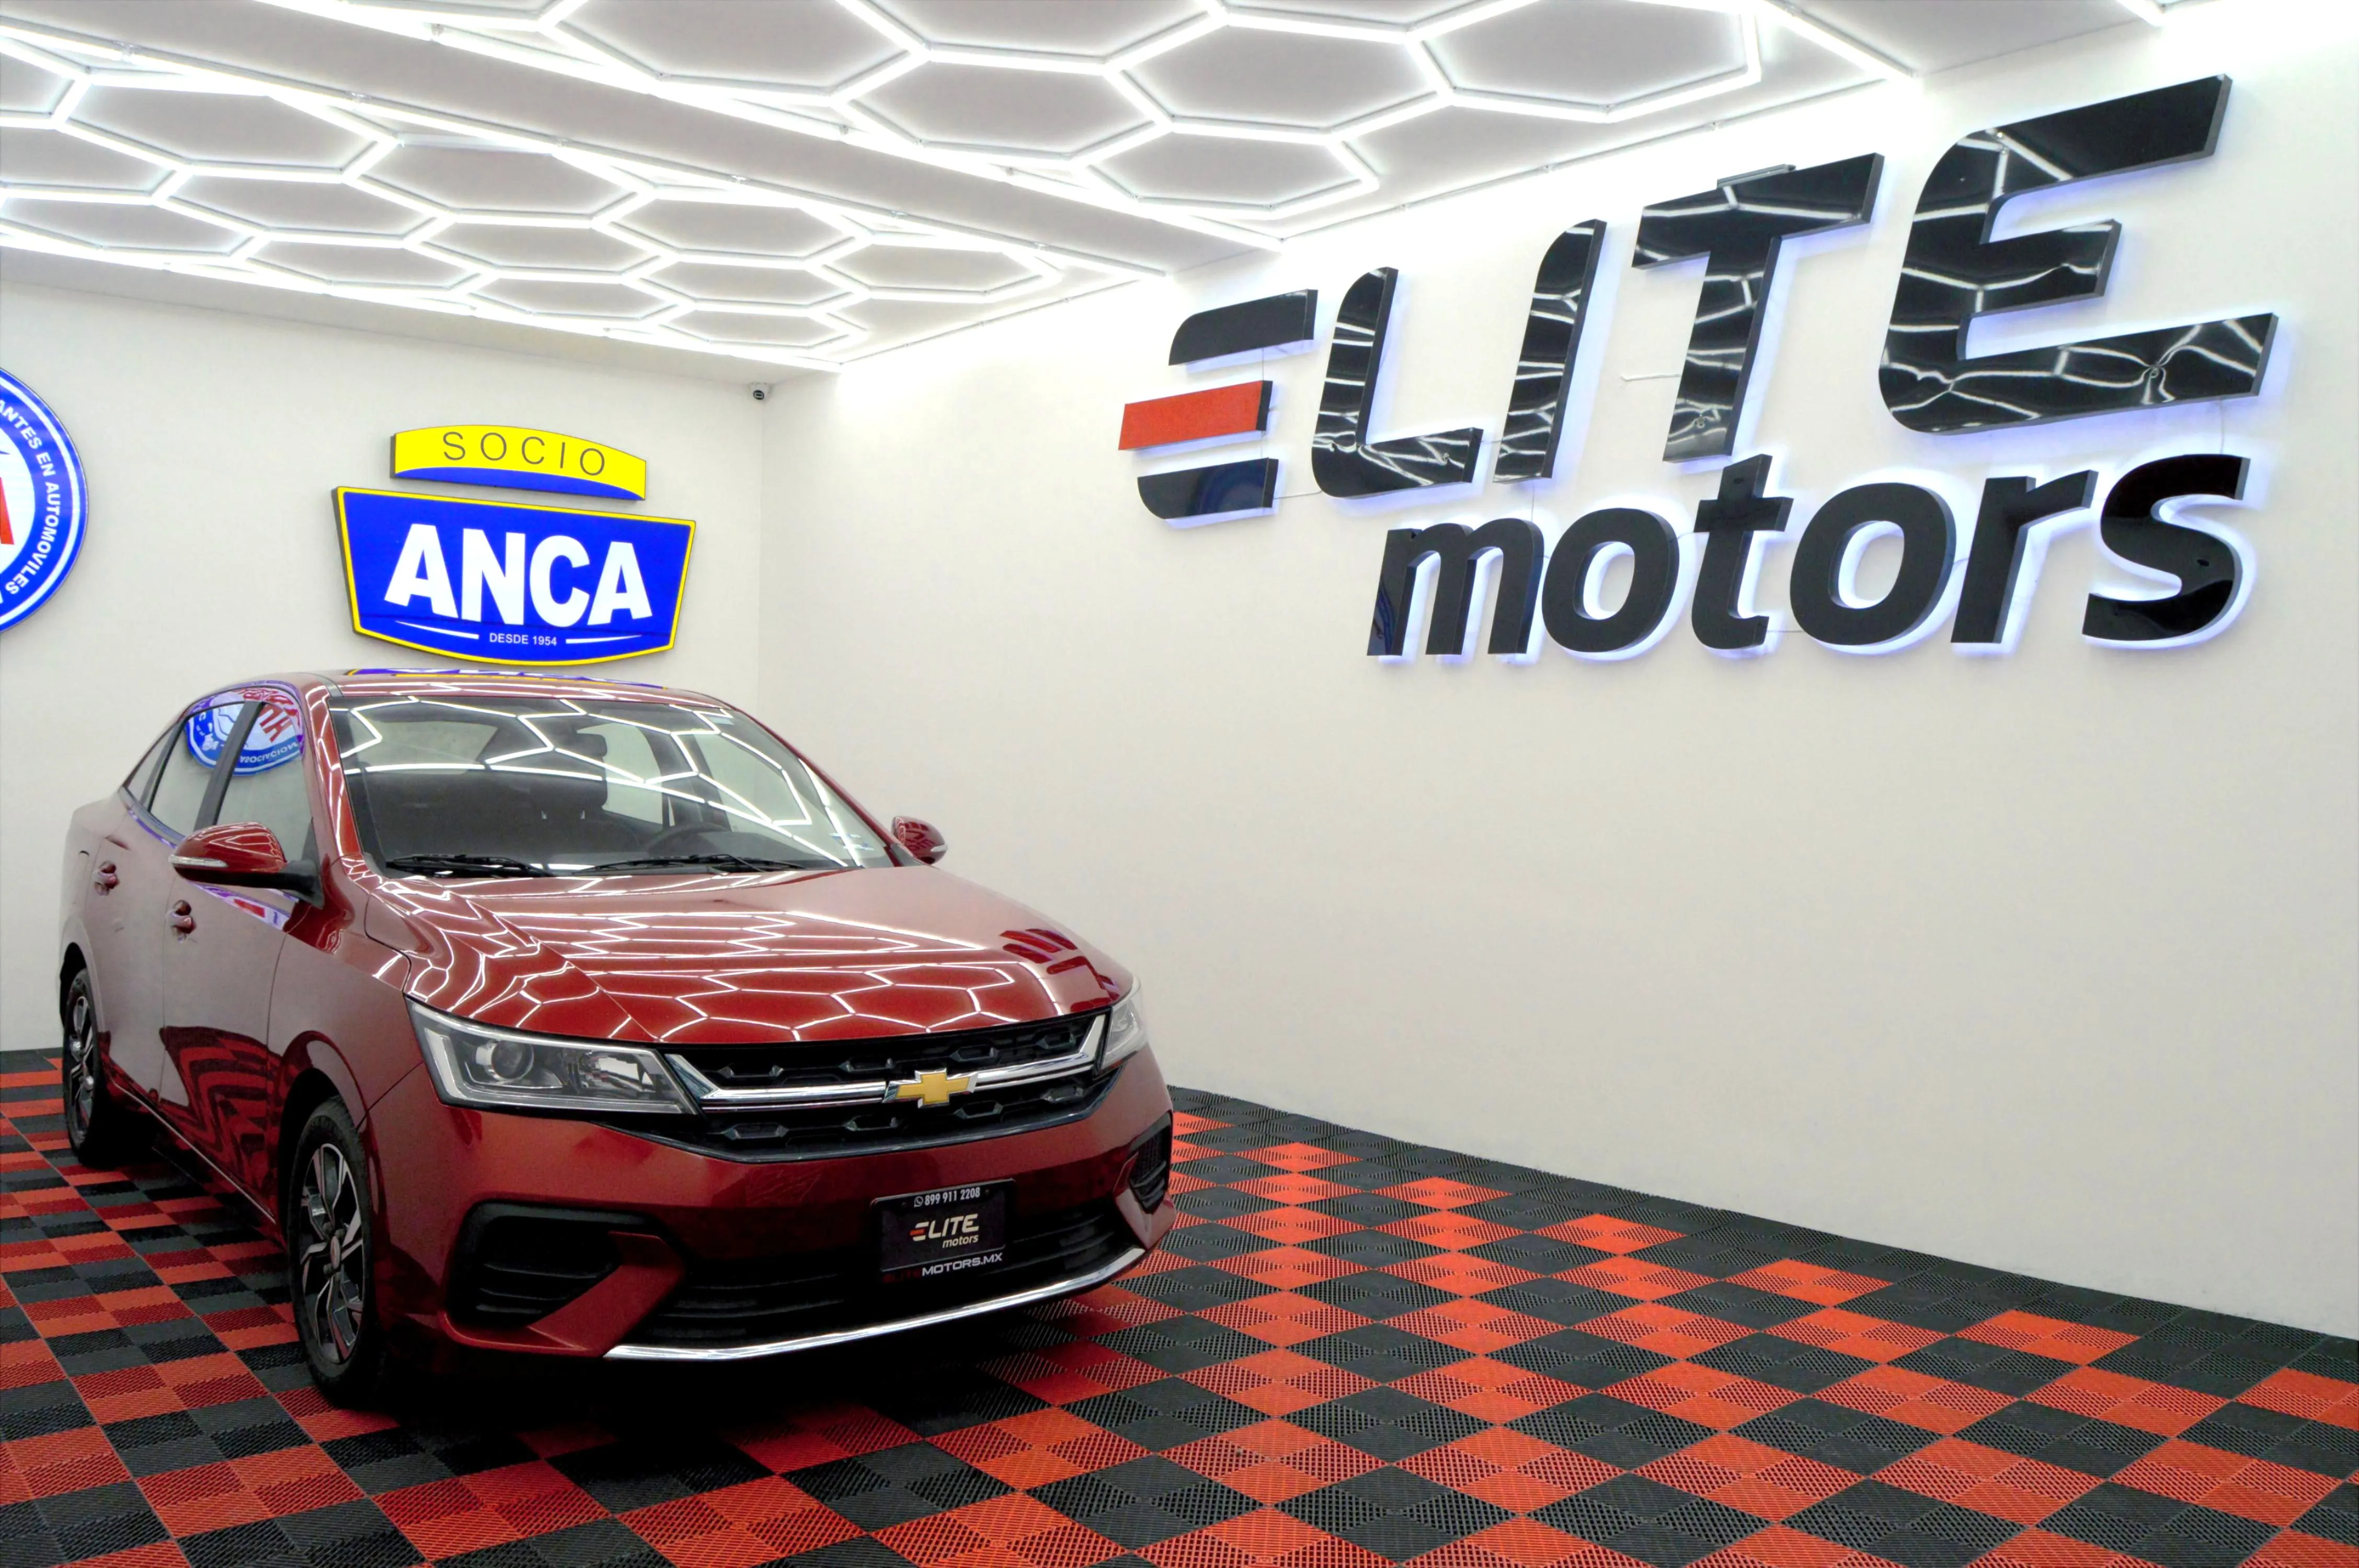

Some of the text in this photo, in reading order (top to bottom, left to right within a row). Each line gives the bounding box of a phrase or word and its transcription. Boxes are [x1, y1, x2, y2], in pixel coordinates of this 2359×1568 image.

[1118, 73, 2278, 523] ELITE
[36, 452, 55, 476] EN
[443, 431, 605, 476] SOCIO
[5, 482, 61, 594] AUTOMOVILES
[1367, 453, 2247, 657] motors
[384, 523, 652, 628] ANCA
[489, 632, 557, 646] DESDE 1954
[924, 1187, 980, 1205] 899 911 2208
[909, 1213, 979, 1241] ELITE
[942, 1234, 979, 1249] motors
